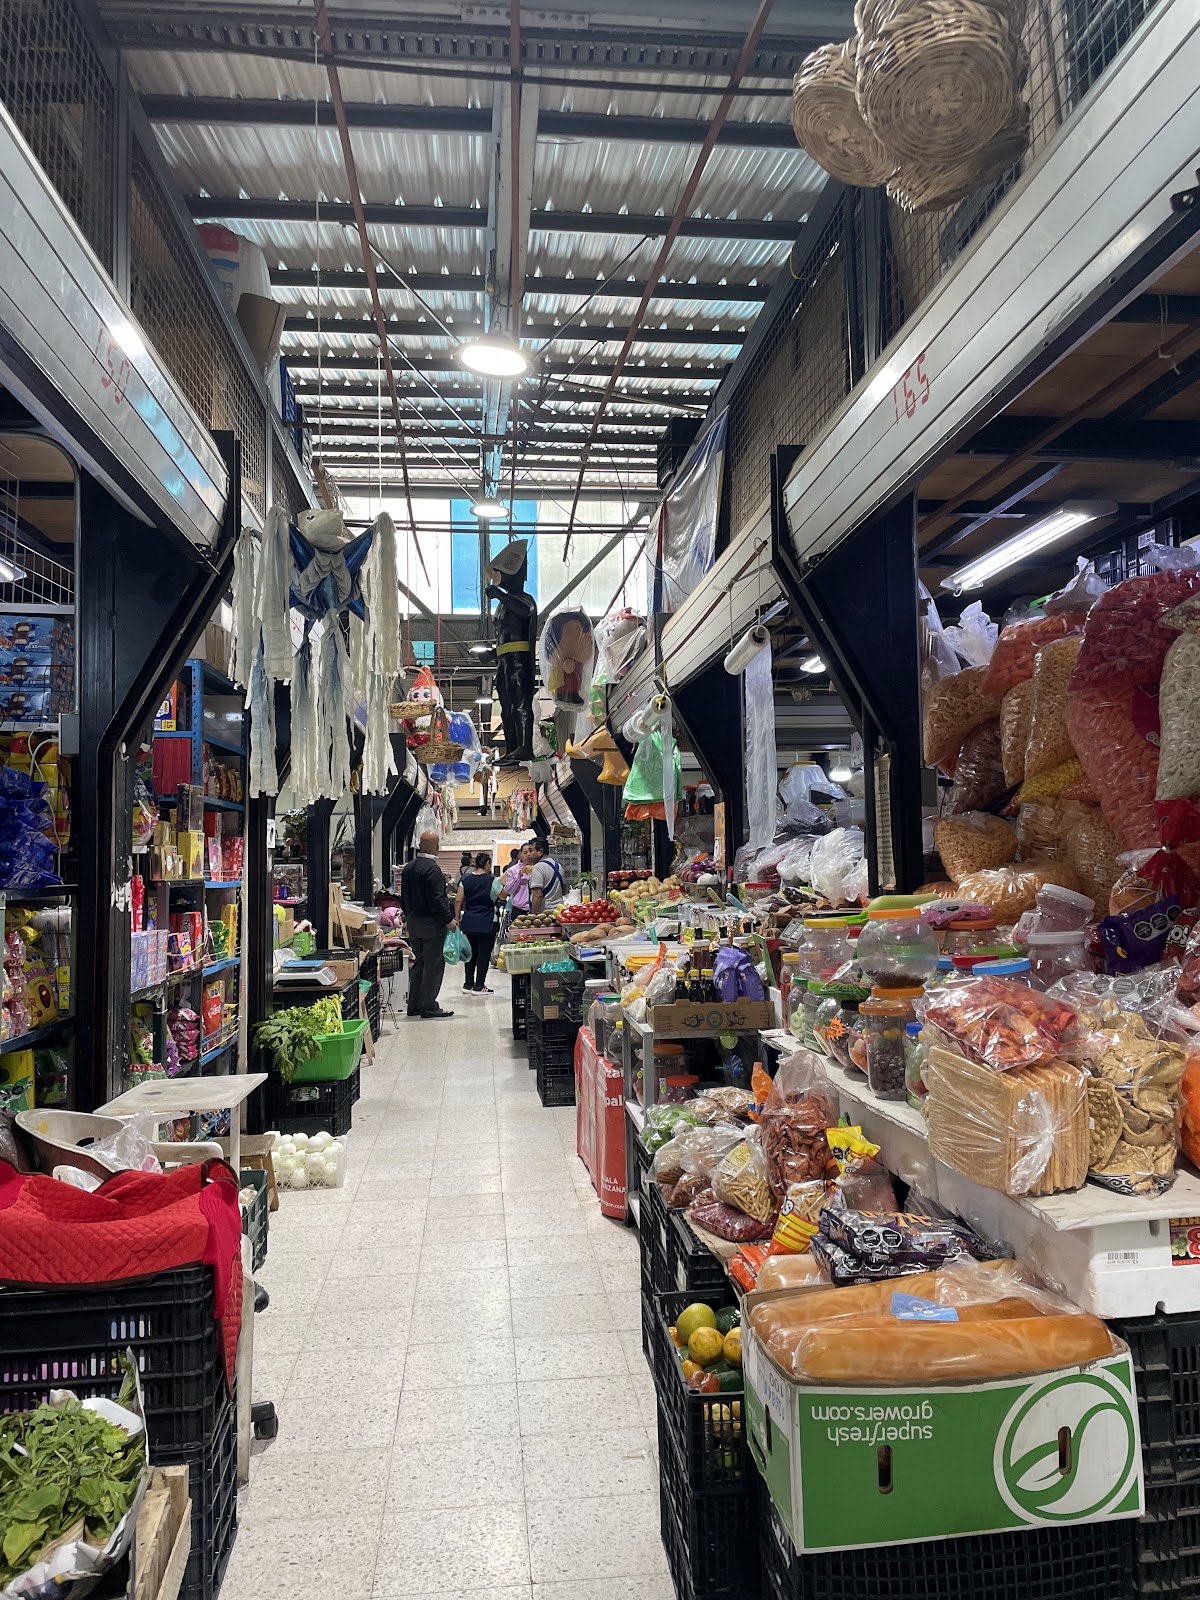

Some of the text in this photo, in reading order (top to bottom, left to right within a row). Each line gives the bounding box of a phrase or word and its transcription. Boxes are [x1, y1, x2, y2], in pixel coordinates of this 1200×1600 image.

[92, 326, 130, 405] 150
[893, 352, 930, 425] 165
[811, 1399, 934, 1421] growers.com
[827, 1420, 933, 1447] superfresh
